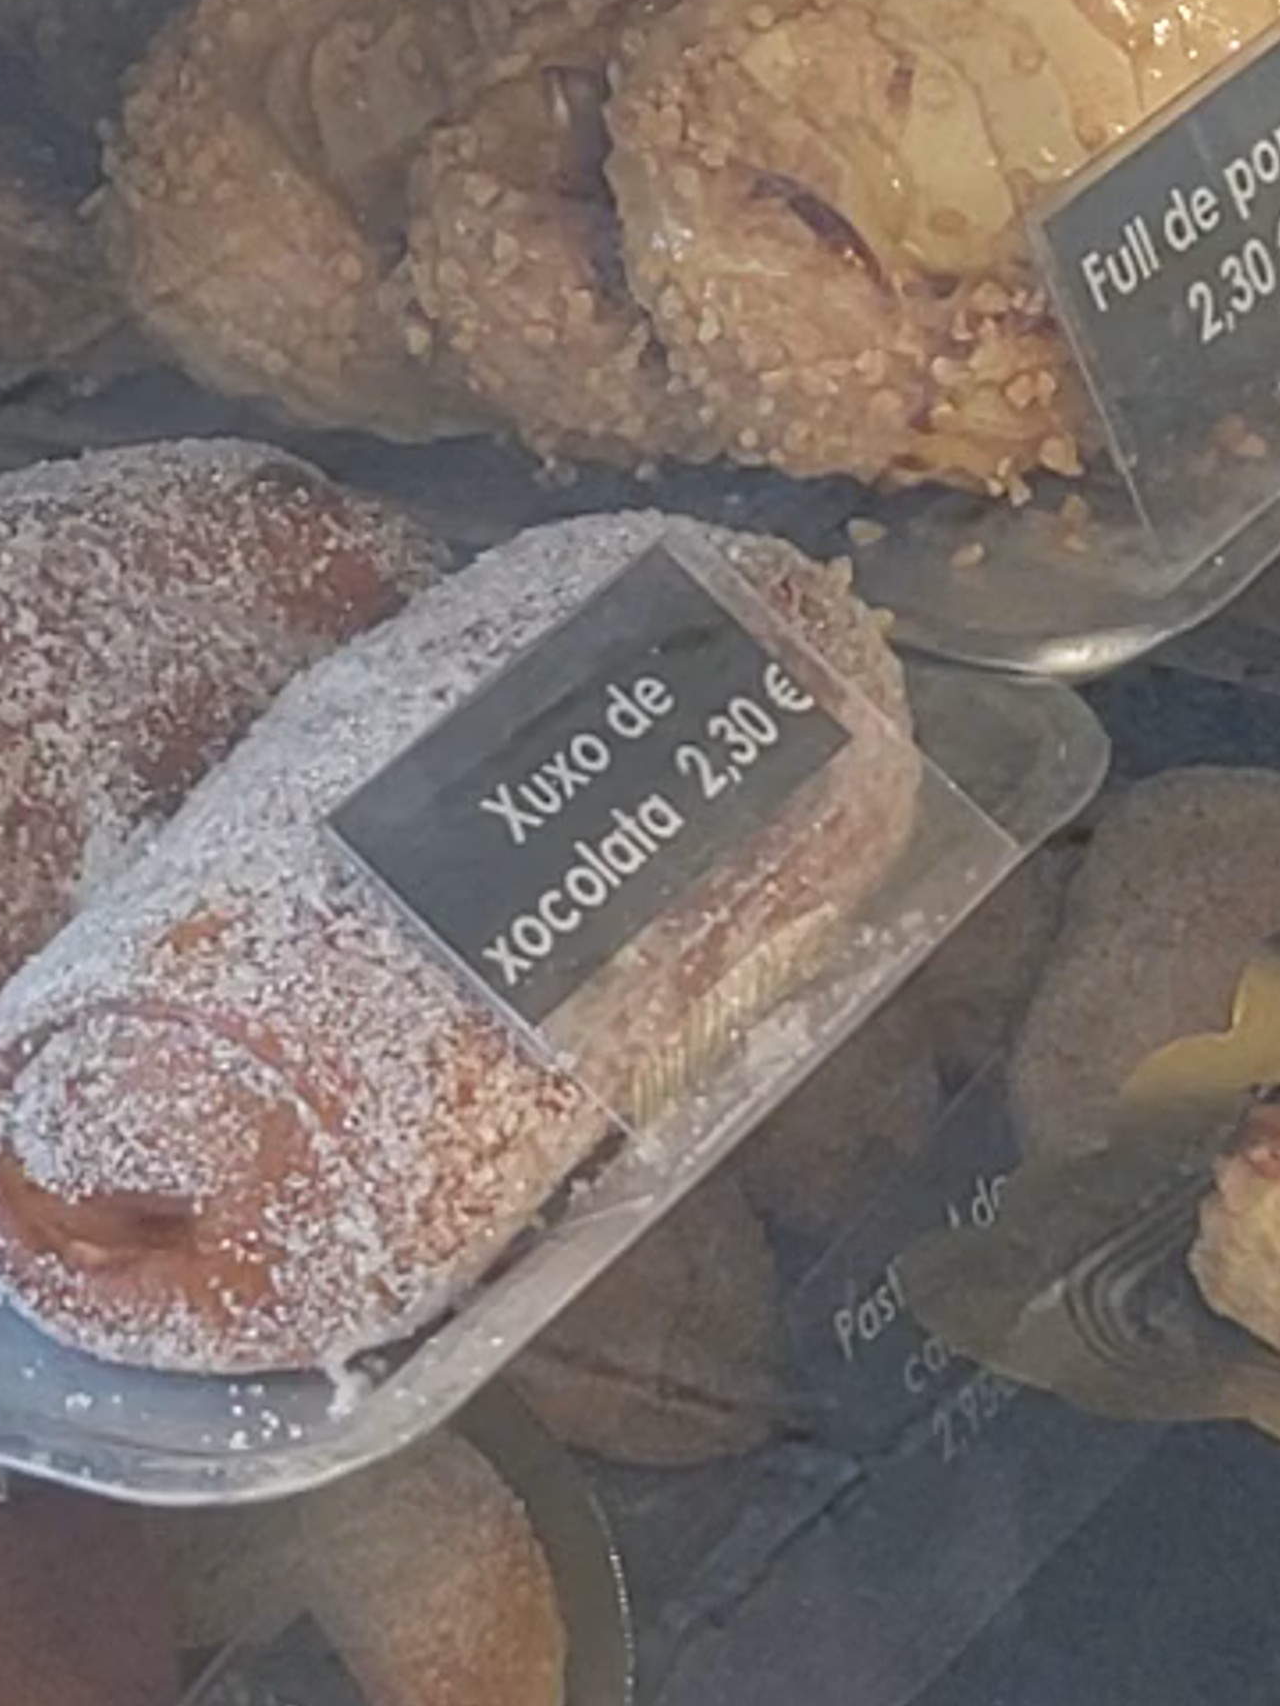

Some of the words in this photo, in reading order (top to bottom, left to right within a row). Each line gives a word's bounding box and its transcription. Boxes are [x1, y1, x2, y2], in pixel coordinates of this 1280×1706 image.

[1081, 216, 1160, 312] Full
[1163, 187, 1220, 252] de
[1187, 238, 1276, 345] 2,30
[480, 732, 611, 844] Xuxo
[606, 675, 675, 739] de
[482, 792, 686, 986] xocolata
[676, 695, 780, 799] 2,30
[763, 662, 816, 713] €
